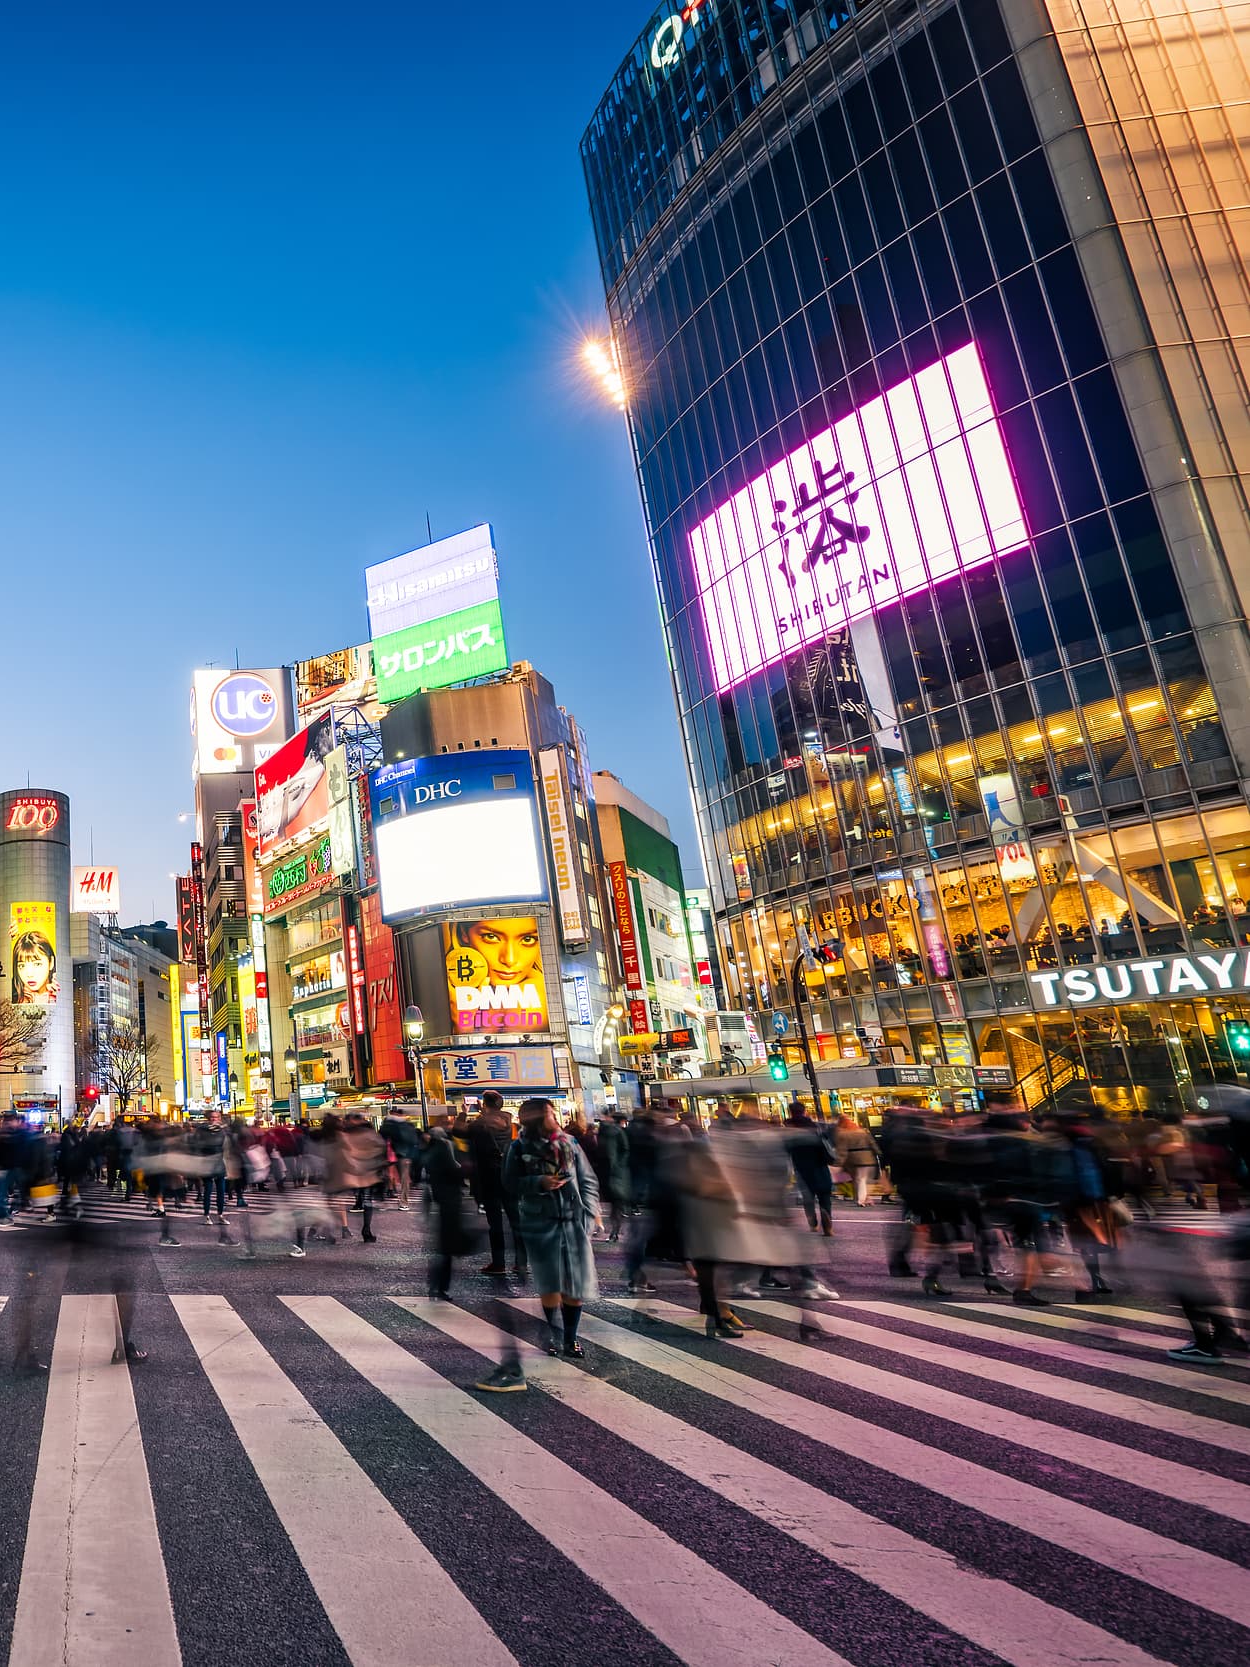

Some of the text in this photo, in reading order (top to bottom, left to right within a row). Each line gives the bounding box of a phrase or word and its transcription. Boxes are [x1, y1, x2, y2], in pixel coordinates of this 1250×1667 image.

[368, 557, 489, 607] Hisamitsu
[777, 563, 891, 635] SHIBUTAN
[379, 623, 496, 679] サロンパス
[219, 690, 272, 720] UC
[375, 766, 416, 787] DHC Channel
[414, 780, 462, 805] DHC
[6, 805, 58, 834] 109
[80, 871, 113, 894] H&M
[553, 836, 570, 890] neon
[612, 865, 641, 984] クスリのことなら 三千里
[370, 961, 393, 1032] クスリ
[455, 983, 542, 1011] DMM
[1031, 952, 1250, 1005] TSUTAY
[459, 1009, 543, 1028] Bitcoin
